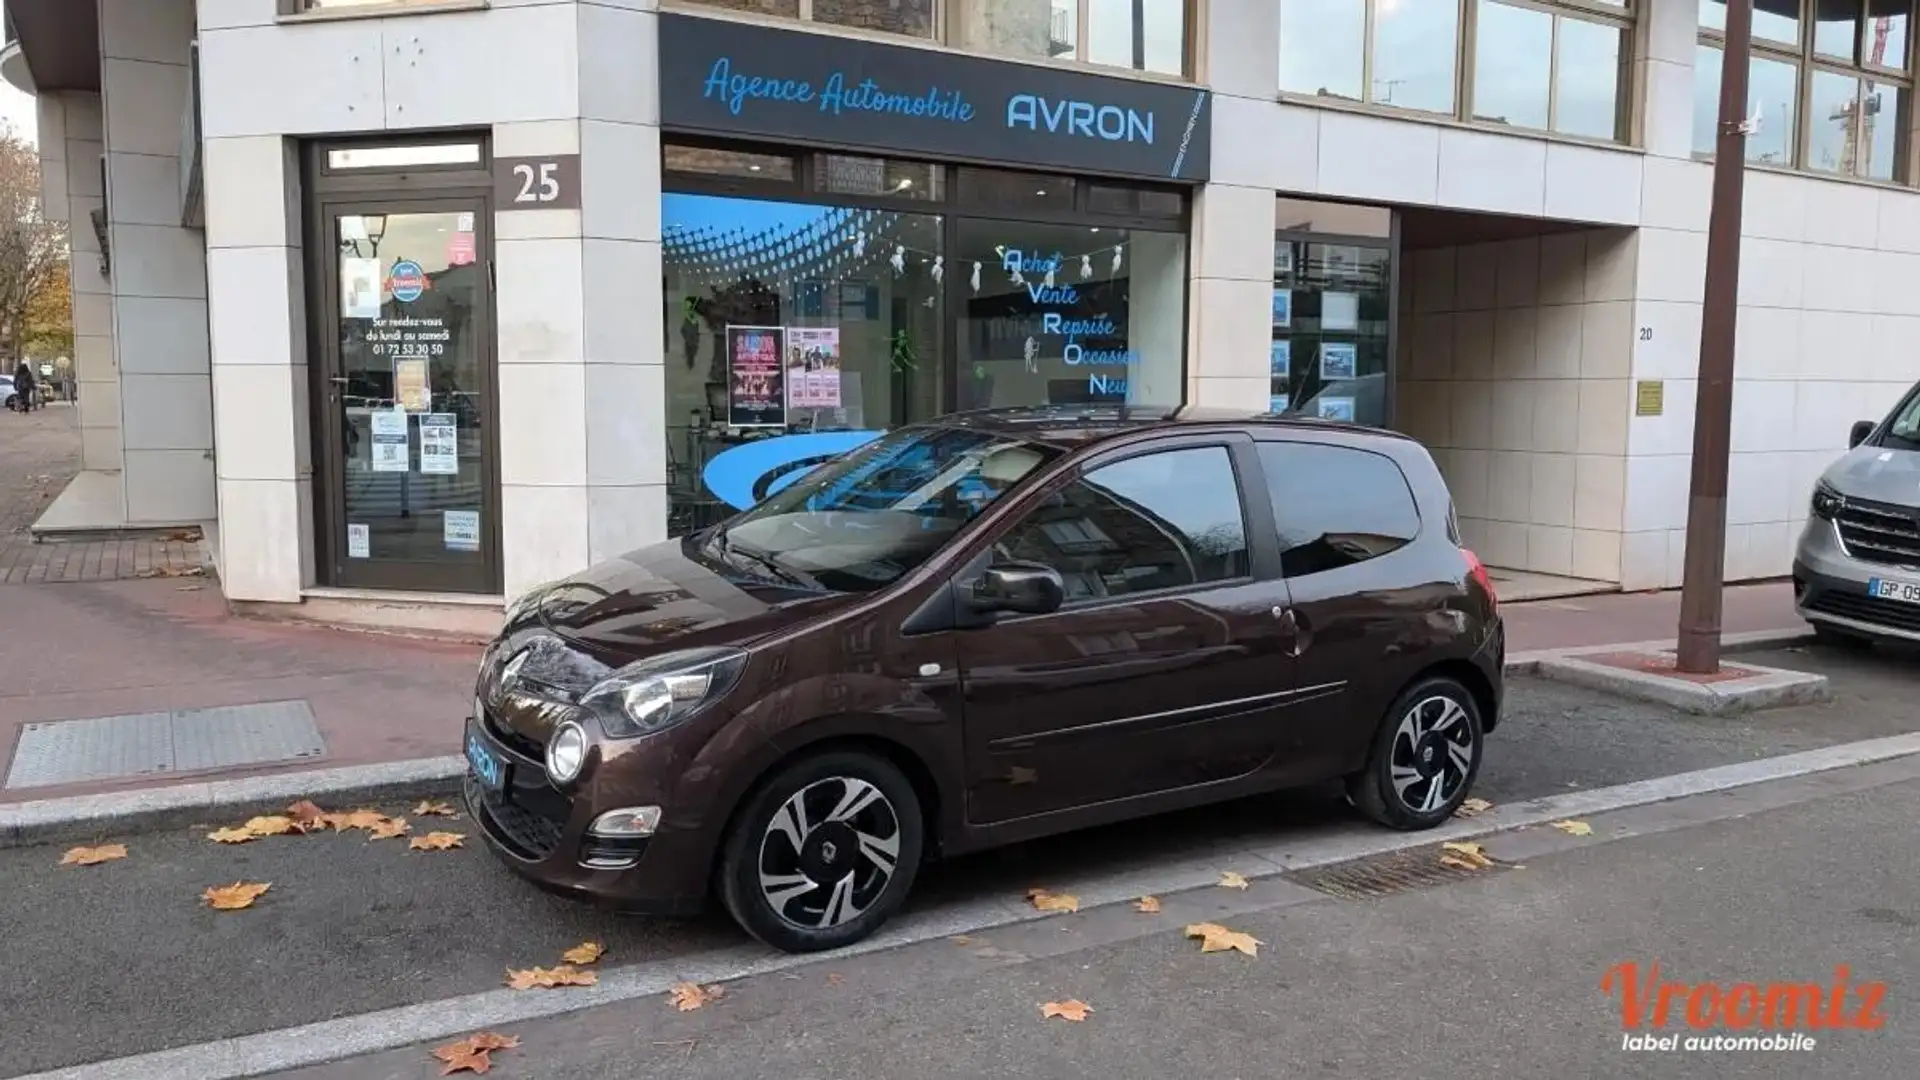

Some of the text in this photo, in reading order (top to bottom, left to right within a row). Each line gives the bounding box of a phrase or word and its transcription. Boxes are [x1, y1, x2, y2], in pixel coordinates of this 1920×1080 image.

[704, 57, 976, 122] Agence Automobile
[1007, 94, 1153, 144] AVRON
[513, 163, 559, 202] 25
[1003, 249, 1063, 272] Achat
[1027, 281, 1080, 304] Vente
[373, 315, 443, 327] Sur rendez-vous
[1043, 312, 1116, 345] Reprise
[381, 329, 401, 341] lundi
[404, 331, 416, 341] au
[418, 328, 450, 341] samedi
[1639, 327, 1653, 341] 20
[373, 343, 444, 355] 01 72 53 30 50
[468, 736, 499, 785] AVRON
